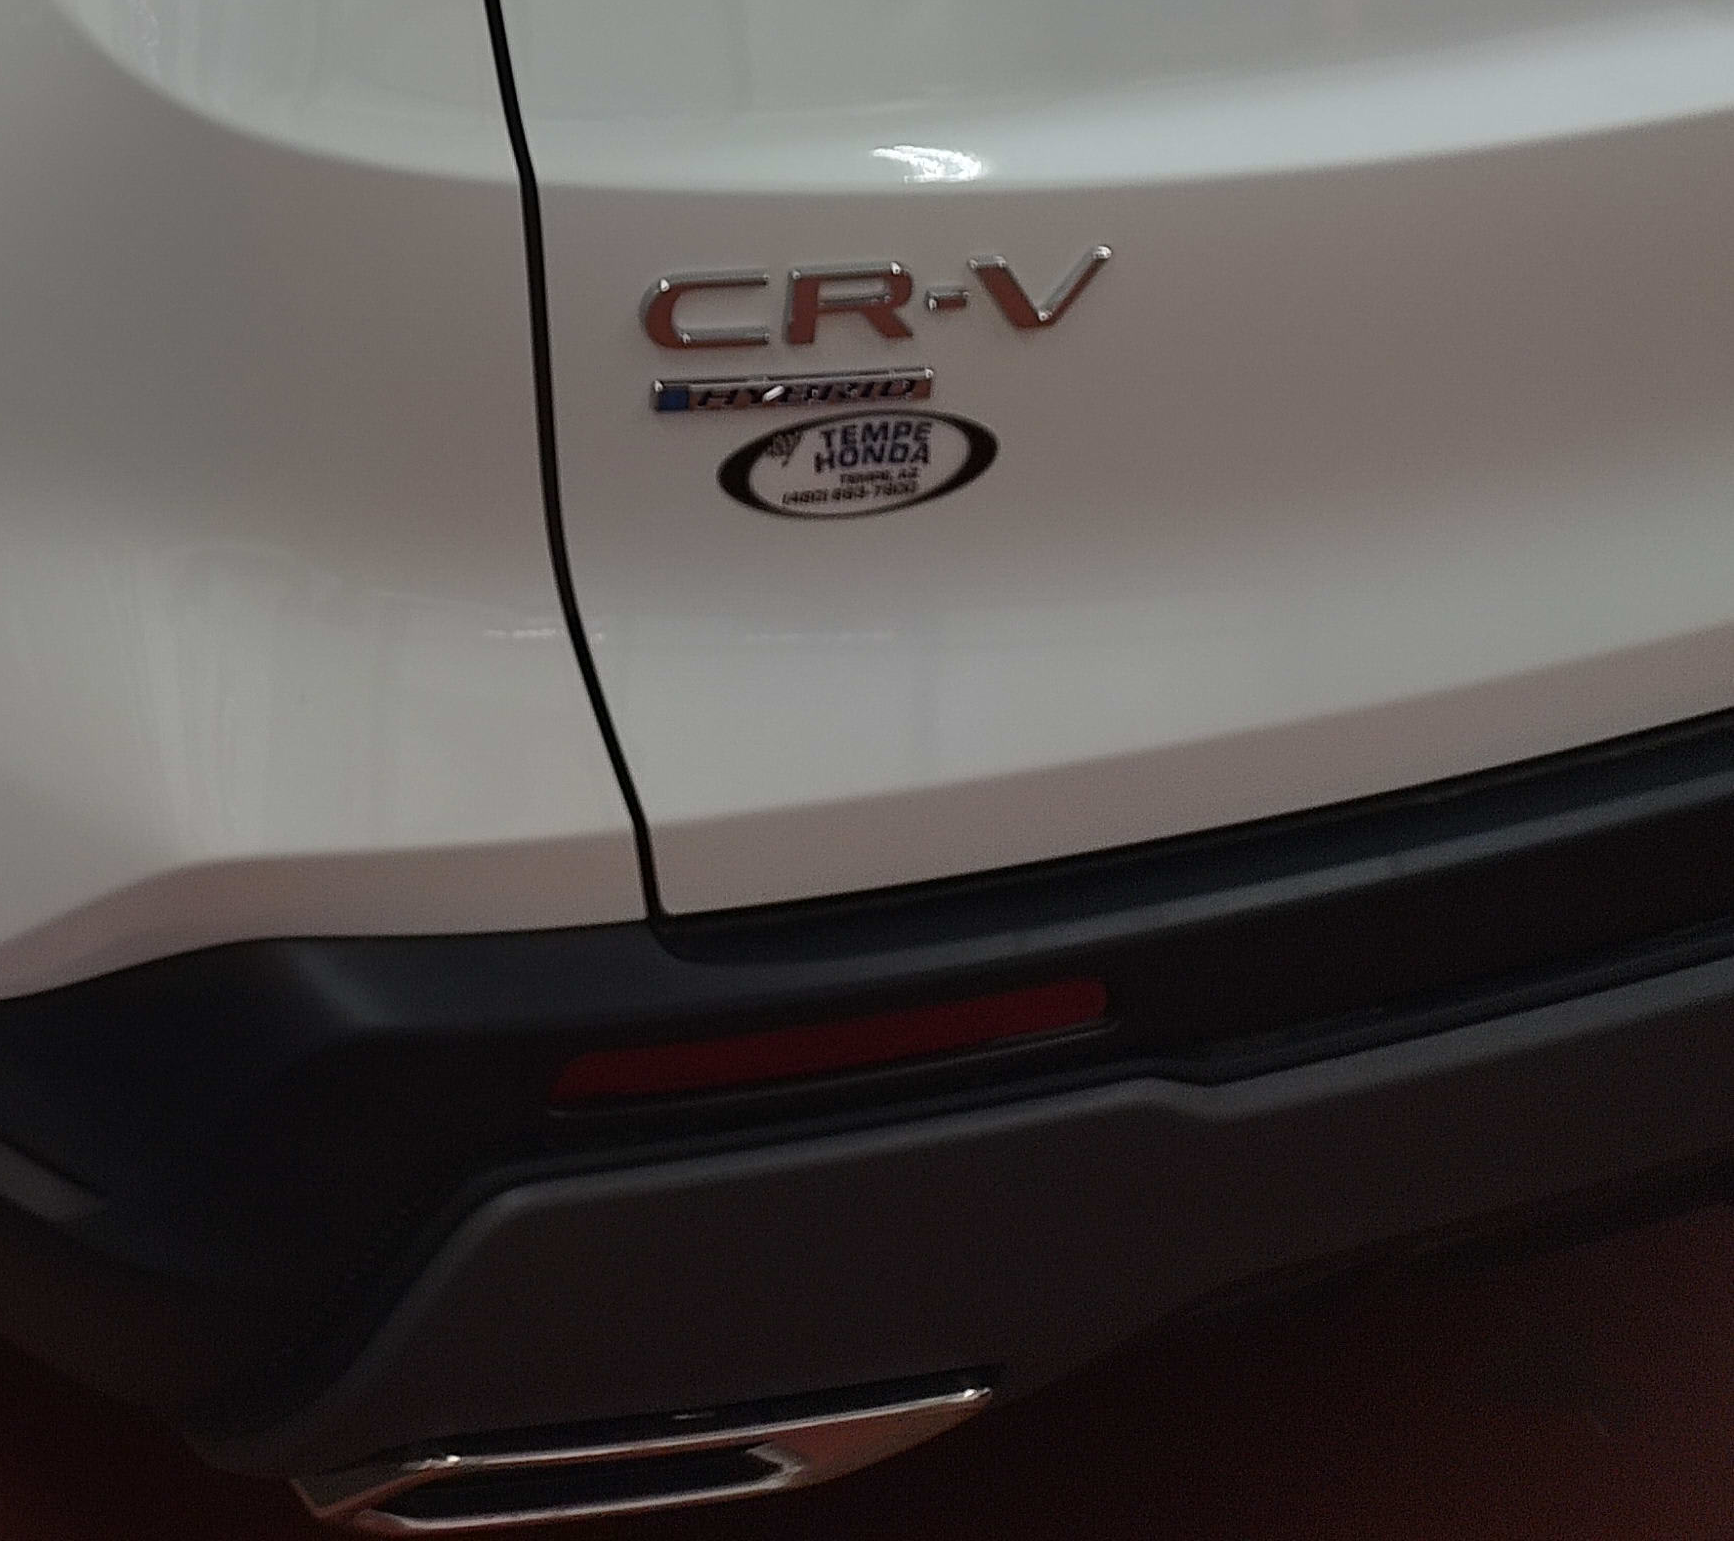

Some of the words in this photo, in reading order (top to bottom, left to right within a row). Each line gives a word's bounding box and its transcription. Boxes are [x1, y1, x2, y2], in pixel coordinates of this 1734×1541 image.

[639, 244, 1113, 348] CR-V
[821, 421, 931, 448] TEMPE
[814, 443, 930, 473] HONDA
